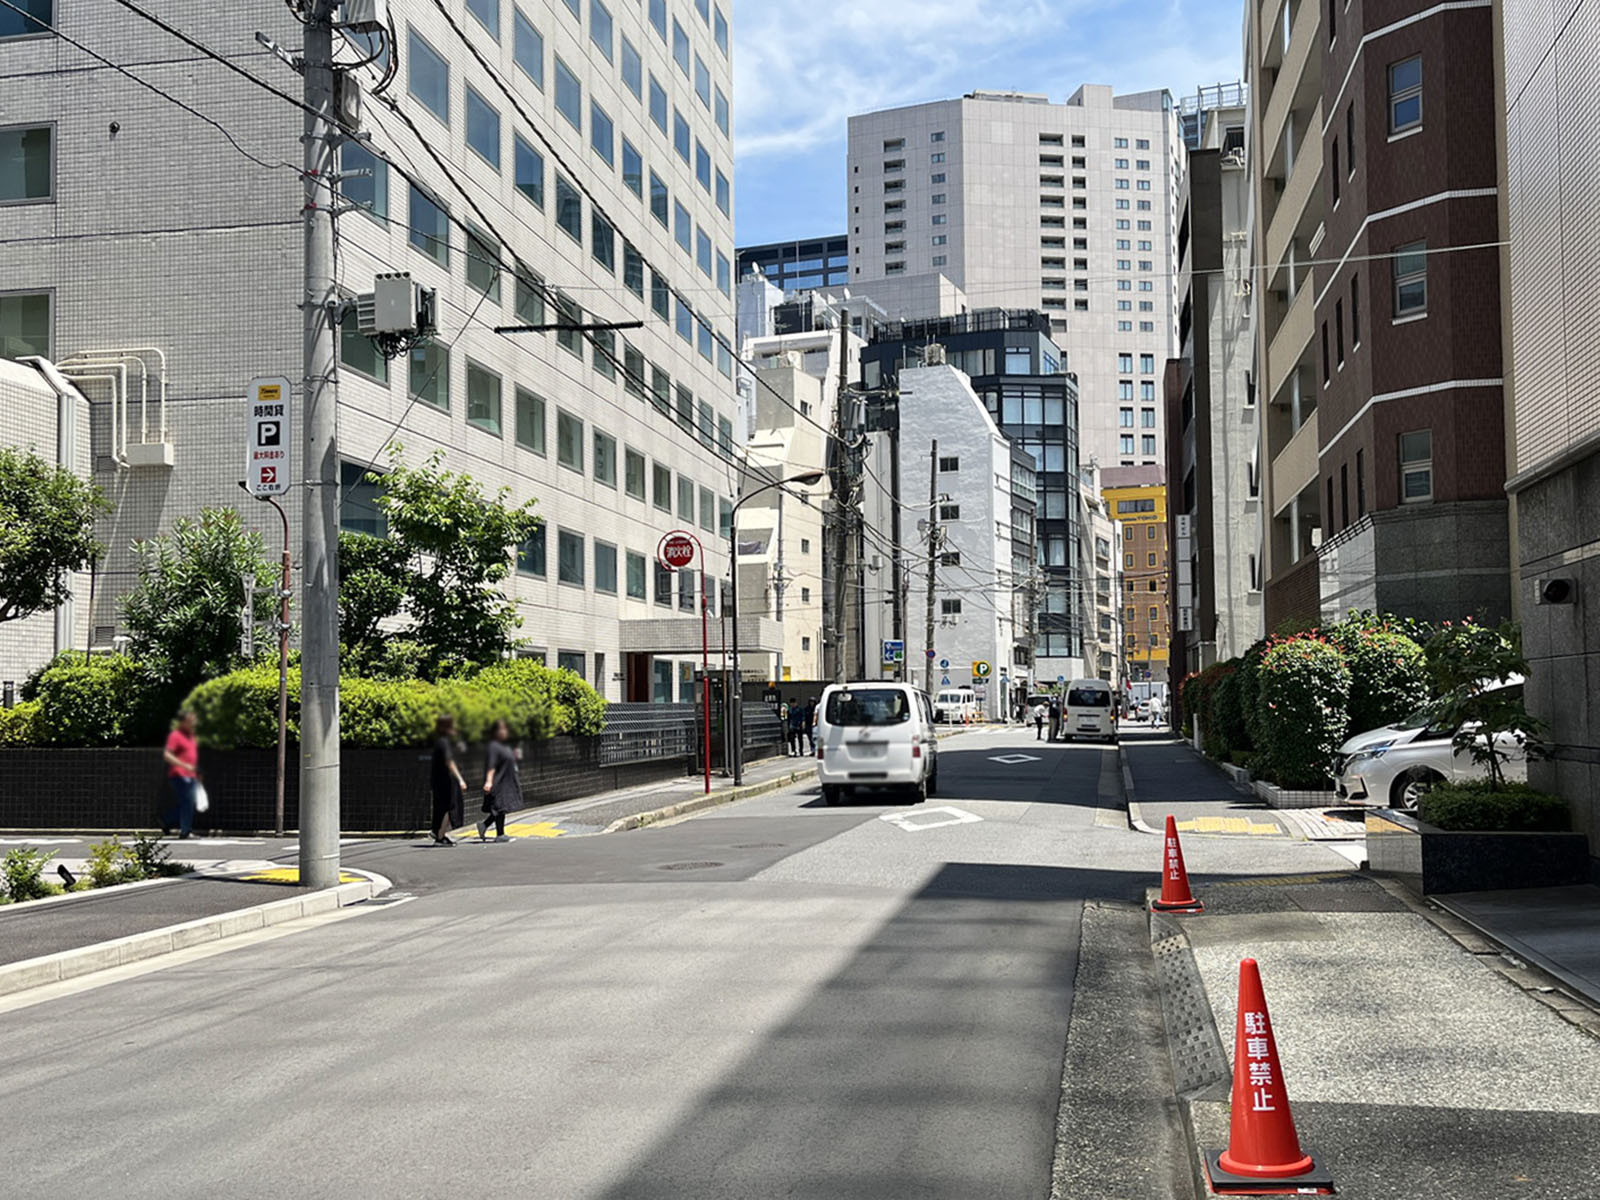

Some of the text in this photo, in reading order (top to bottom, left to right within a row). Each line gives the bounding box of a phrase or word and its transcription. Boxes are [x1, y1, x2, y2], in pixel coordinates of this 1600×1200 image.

[254, 404, 284, 417] 時間貸
[261, 424, 277, 444] P
[666, 545, 692, 558] 消火栓
[979, 663, 988, 675] P
[1167, 837, 1180, 880] 駐車禁止
[1244, 1011, 1276, 1112] 駐車禁止
